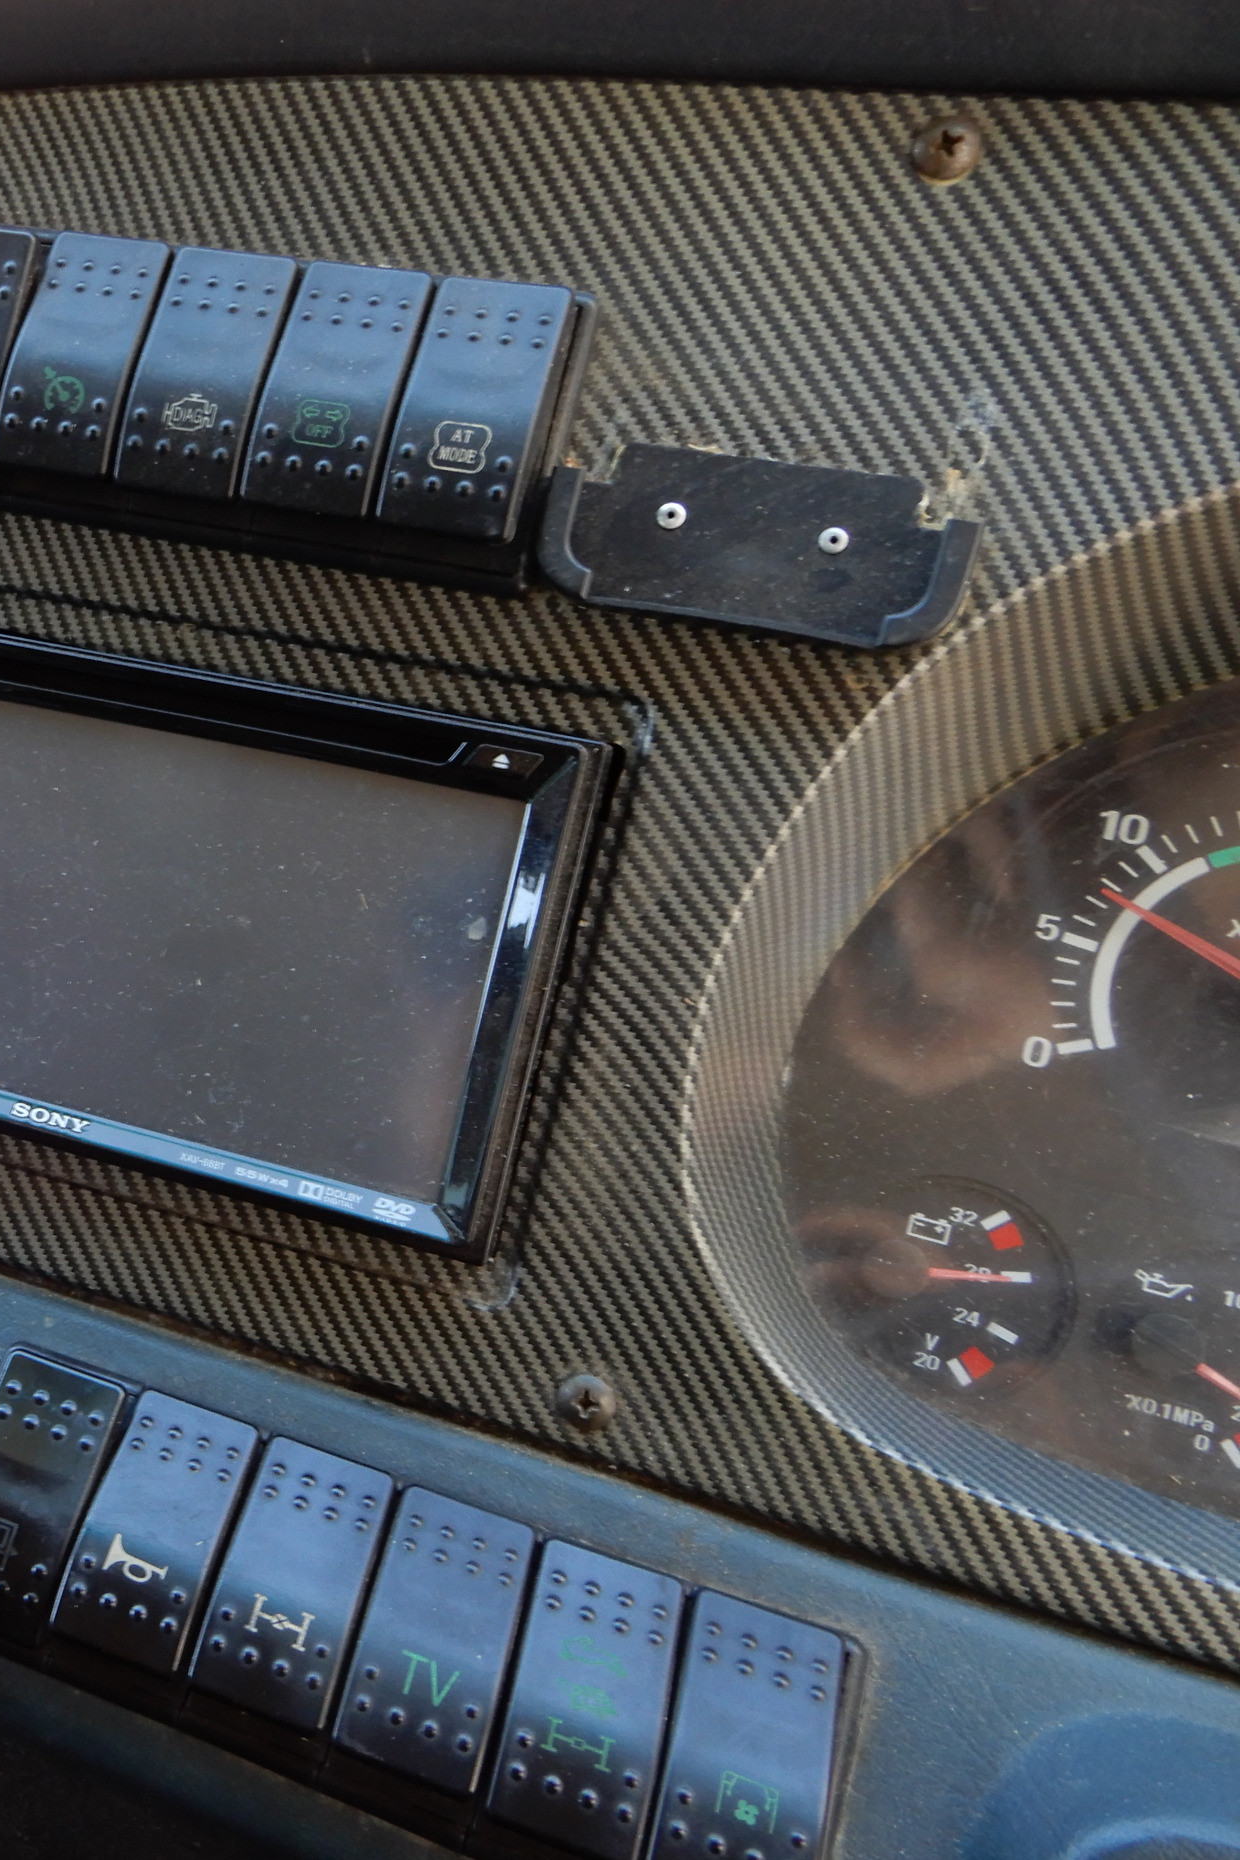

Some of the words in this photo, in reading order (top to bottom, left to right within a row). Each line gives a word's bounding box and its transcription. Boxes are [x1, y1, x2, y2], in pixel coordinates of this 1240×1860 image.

[173, 406, 203, 424] DIAG
[305, 424, 333, 439] OFF
[450, 429, 475, 444] AT
[437, 445, 478, 465] MODE
[1099, 810, 1150, 845] 10
[1035, 913, 1062, 941] 5
[1021, 1036, 1054, 1068] 0
[10, 1102, 92, 1133] SONY
[374, 1197, 416, 1216] DVD
[949, 1207, 978, 1226] 32
[953, 1307, 980, 1327] 24
[924, 1333, 940, 1351] V
[913, 1353, 941, 1371] 20
[1193, 1433, 1210, 1451] 0
[402, 1650, 459, 1707] TV
